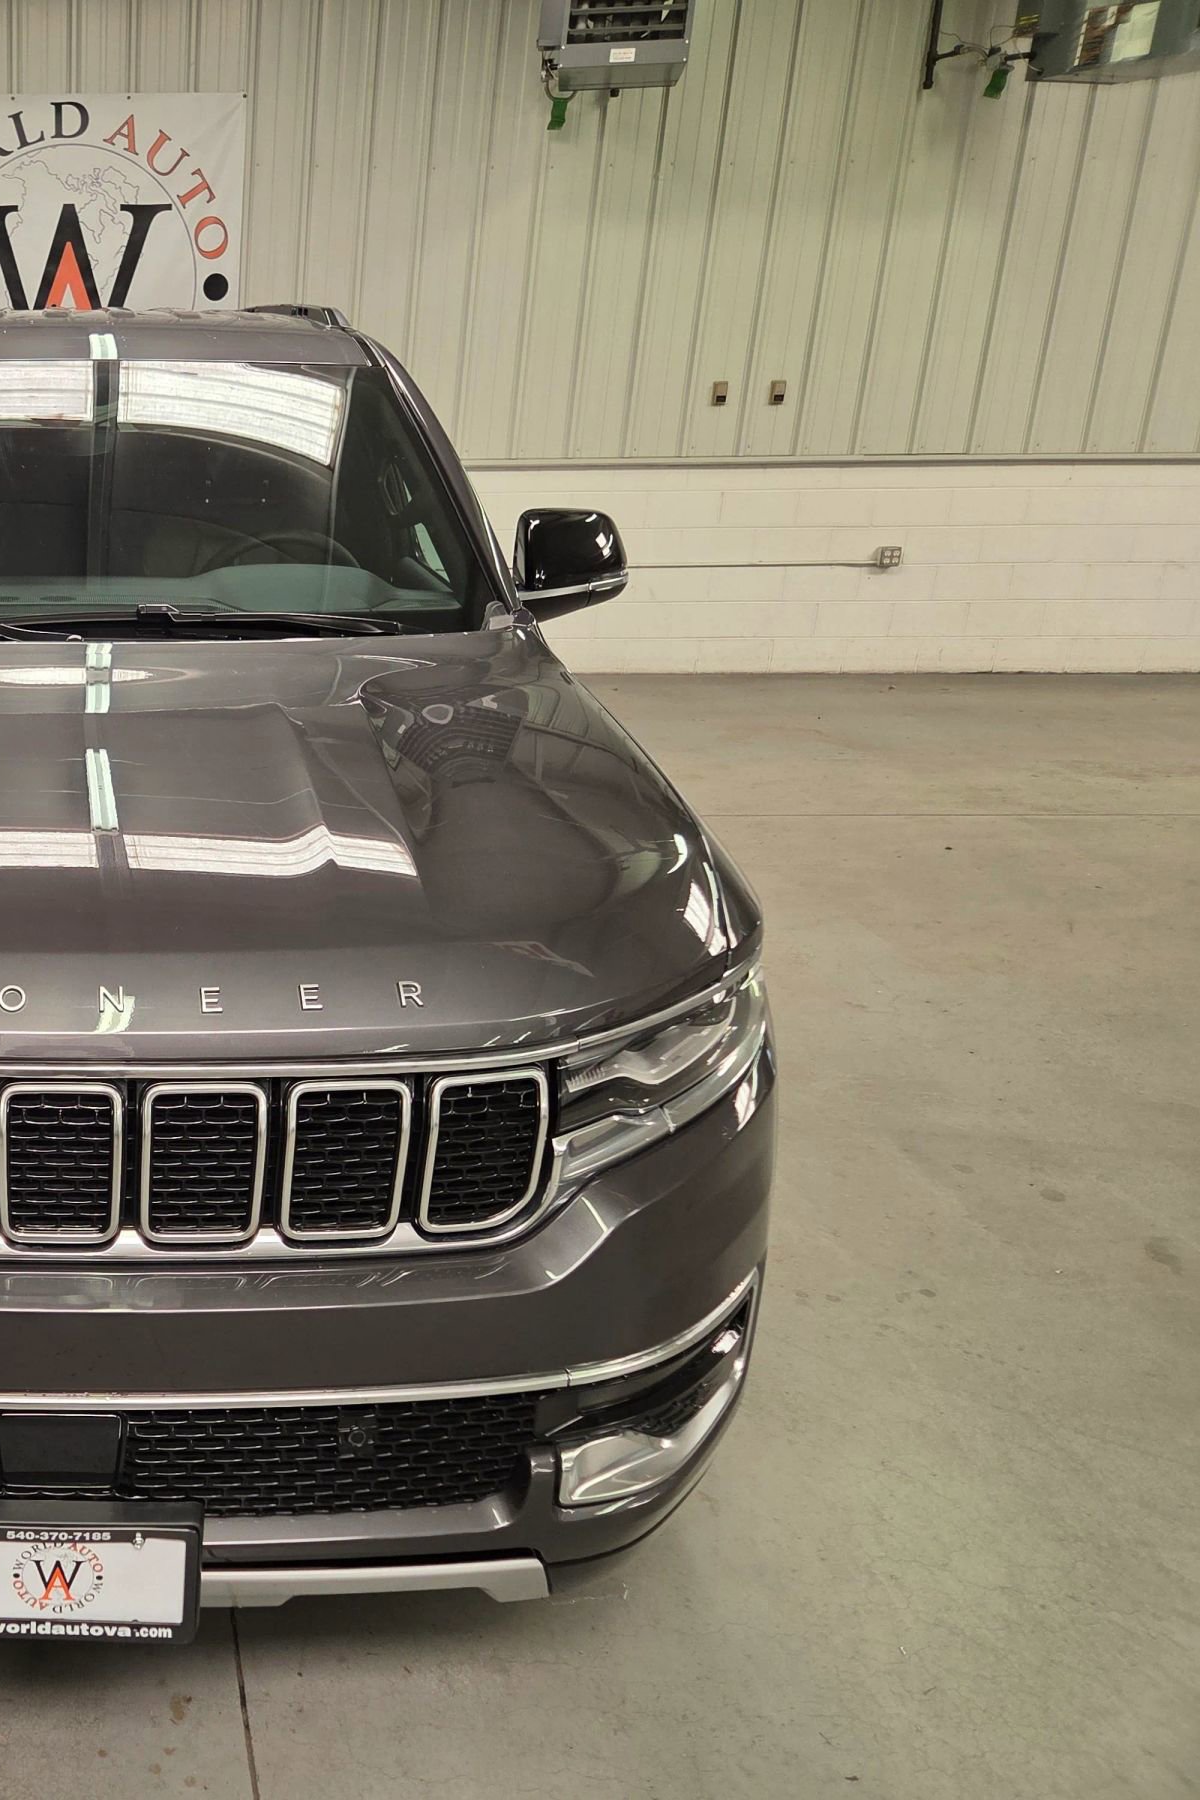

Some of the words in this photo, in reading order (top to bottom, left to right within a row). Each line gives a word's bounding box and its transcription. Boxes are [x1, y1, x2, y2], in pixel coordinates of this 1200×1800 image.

[103, 114, 228, 259] AUTO
[6, 1530, 111, 1541] 540-370-7185
[68, 1542, 104, 1573] AUTO
[13, 1580, 48, 1611] AUTO
